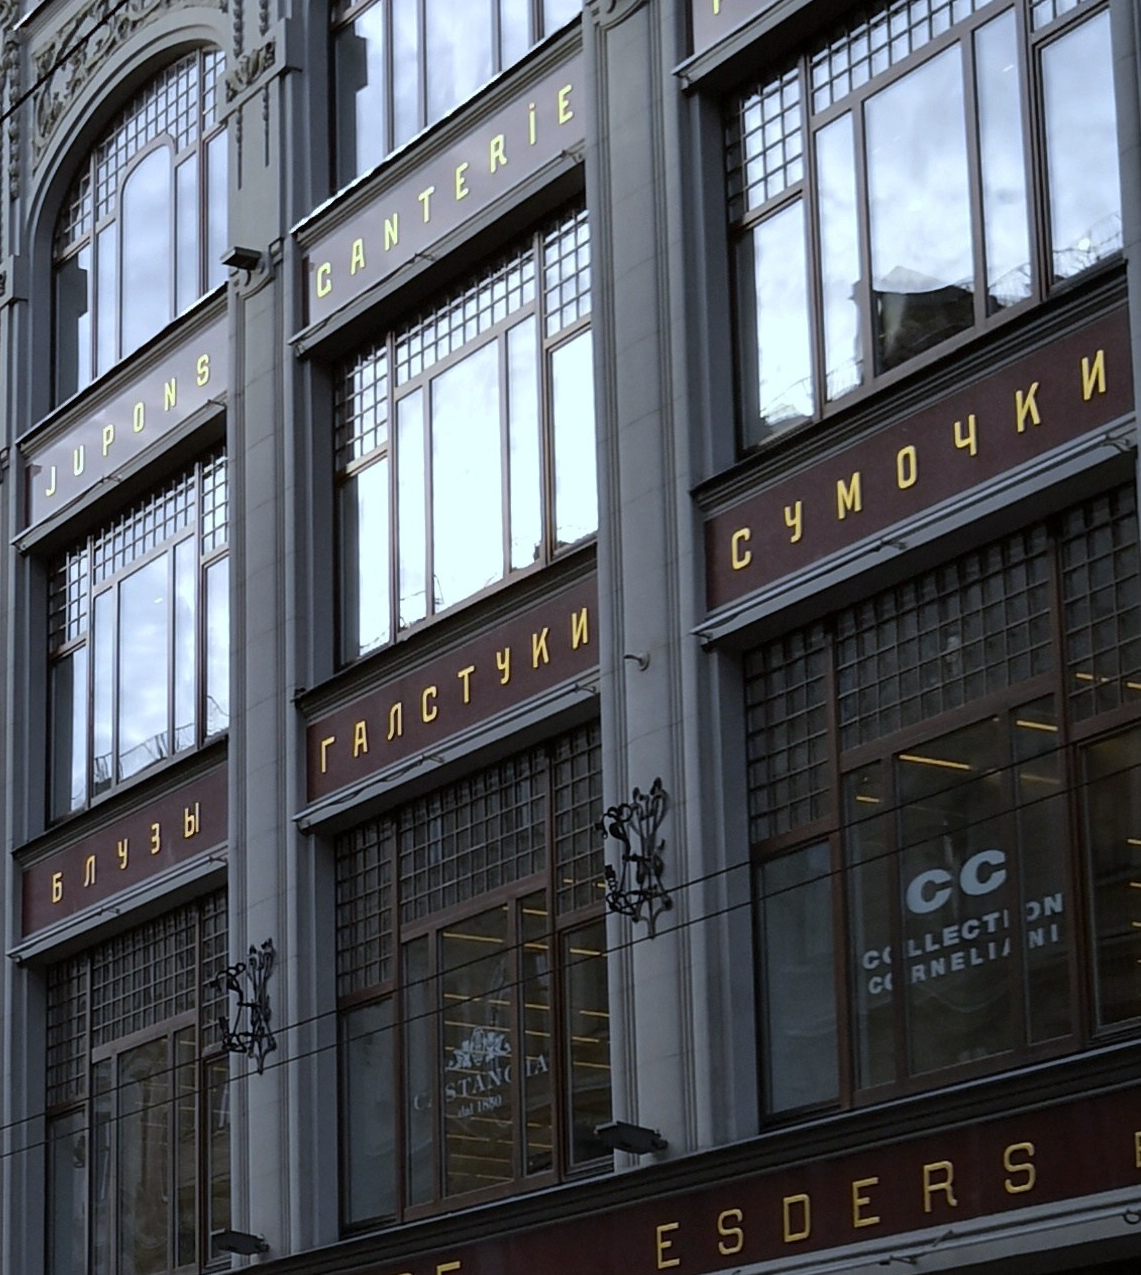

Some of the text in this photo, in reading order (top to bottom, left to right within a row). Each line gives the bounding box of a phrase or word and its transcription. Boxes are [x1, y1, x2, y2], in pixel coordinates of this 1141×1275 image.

[45, 354, 209, 497] JUPONS
[731, 349, 1107, 570] СУМОЧКИ
[320, 607, 588, 773] ГАЛСТУКИ
[52, 802, 200, 903] БЛУЗЫ
[413, 1054, 549, 1111] CSTANIA
[656, 1140, 1037, 1270] ESDERS
